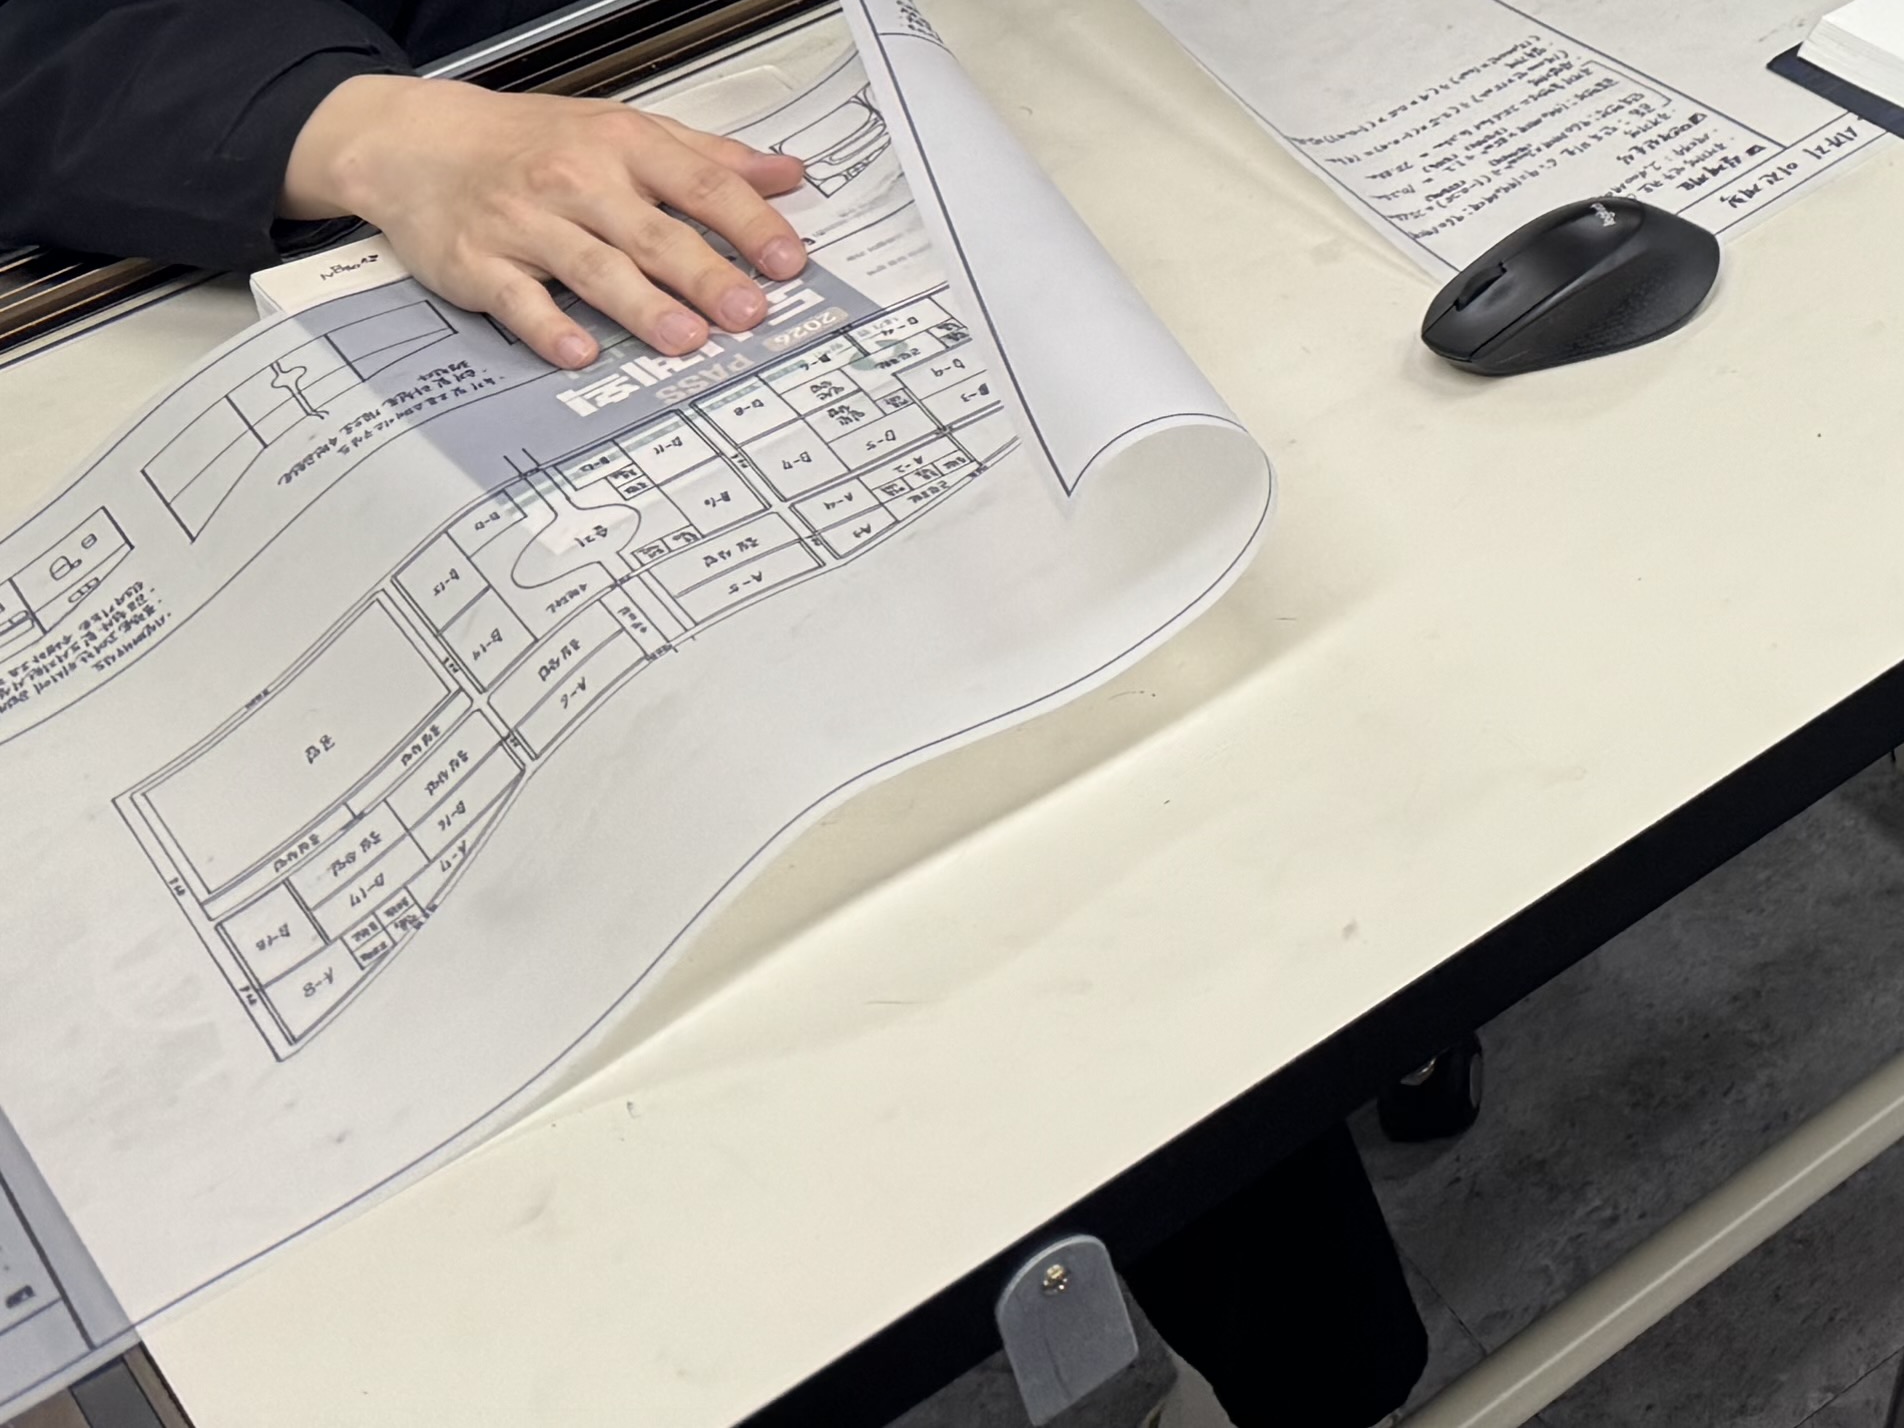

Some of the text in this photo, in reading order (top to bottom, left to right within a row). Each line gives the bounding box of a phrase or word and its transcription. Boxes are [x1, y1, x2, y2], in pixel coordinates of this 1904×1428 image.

[656, 314, 838, 405] 2026 PASS
[892, 454, 923, 473] A-2
[728, 570, 763, 595] A-5
[559, 676, 586, 709] A-6
